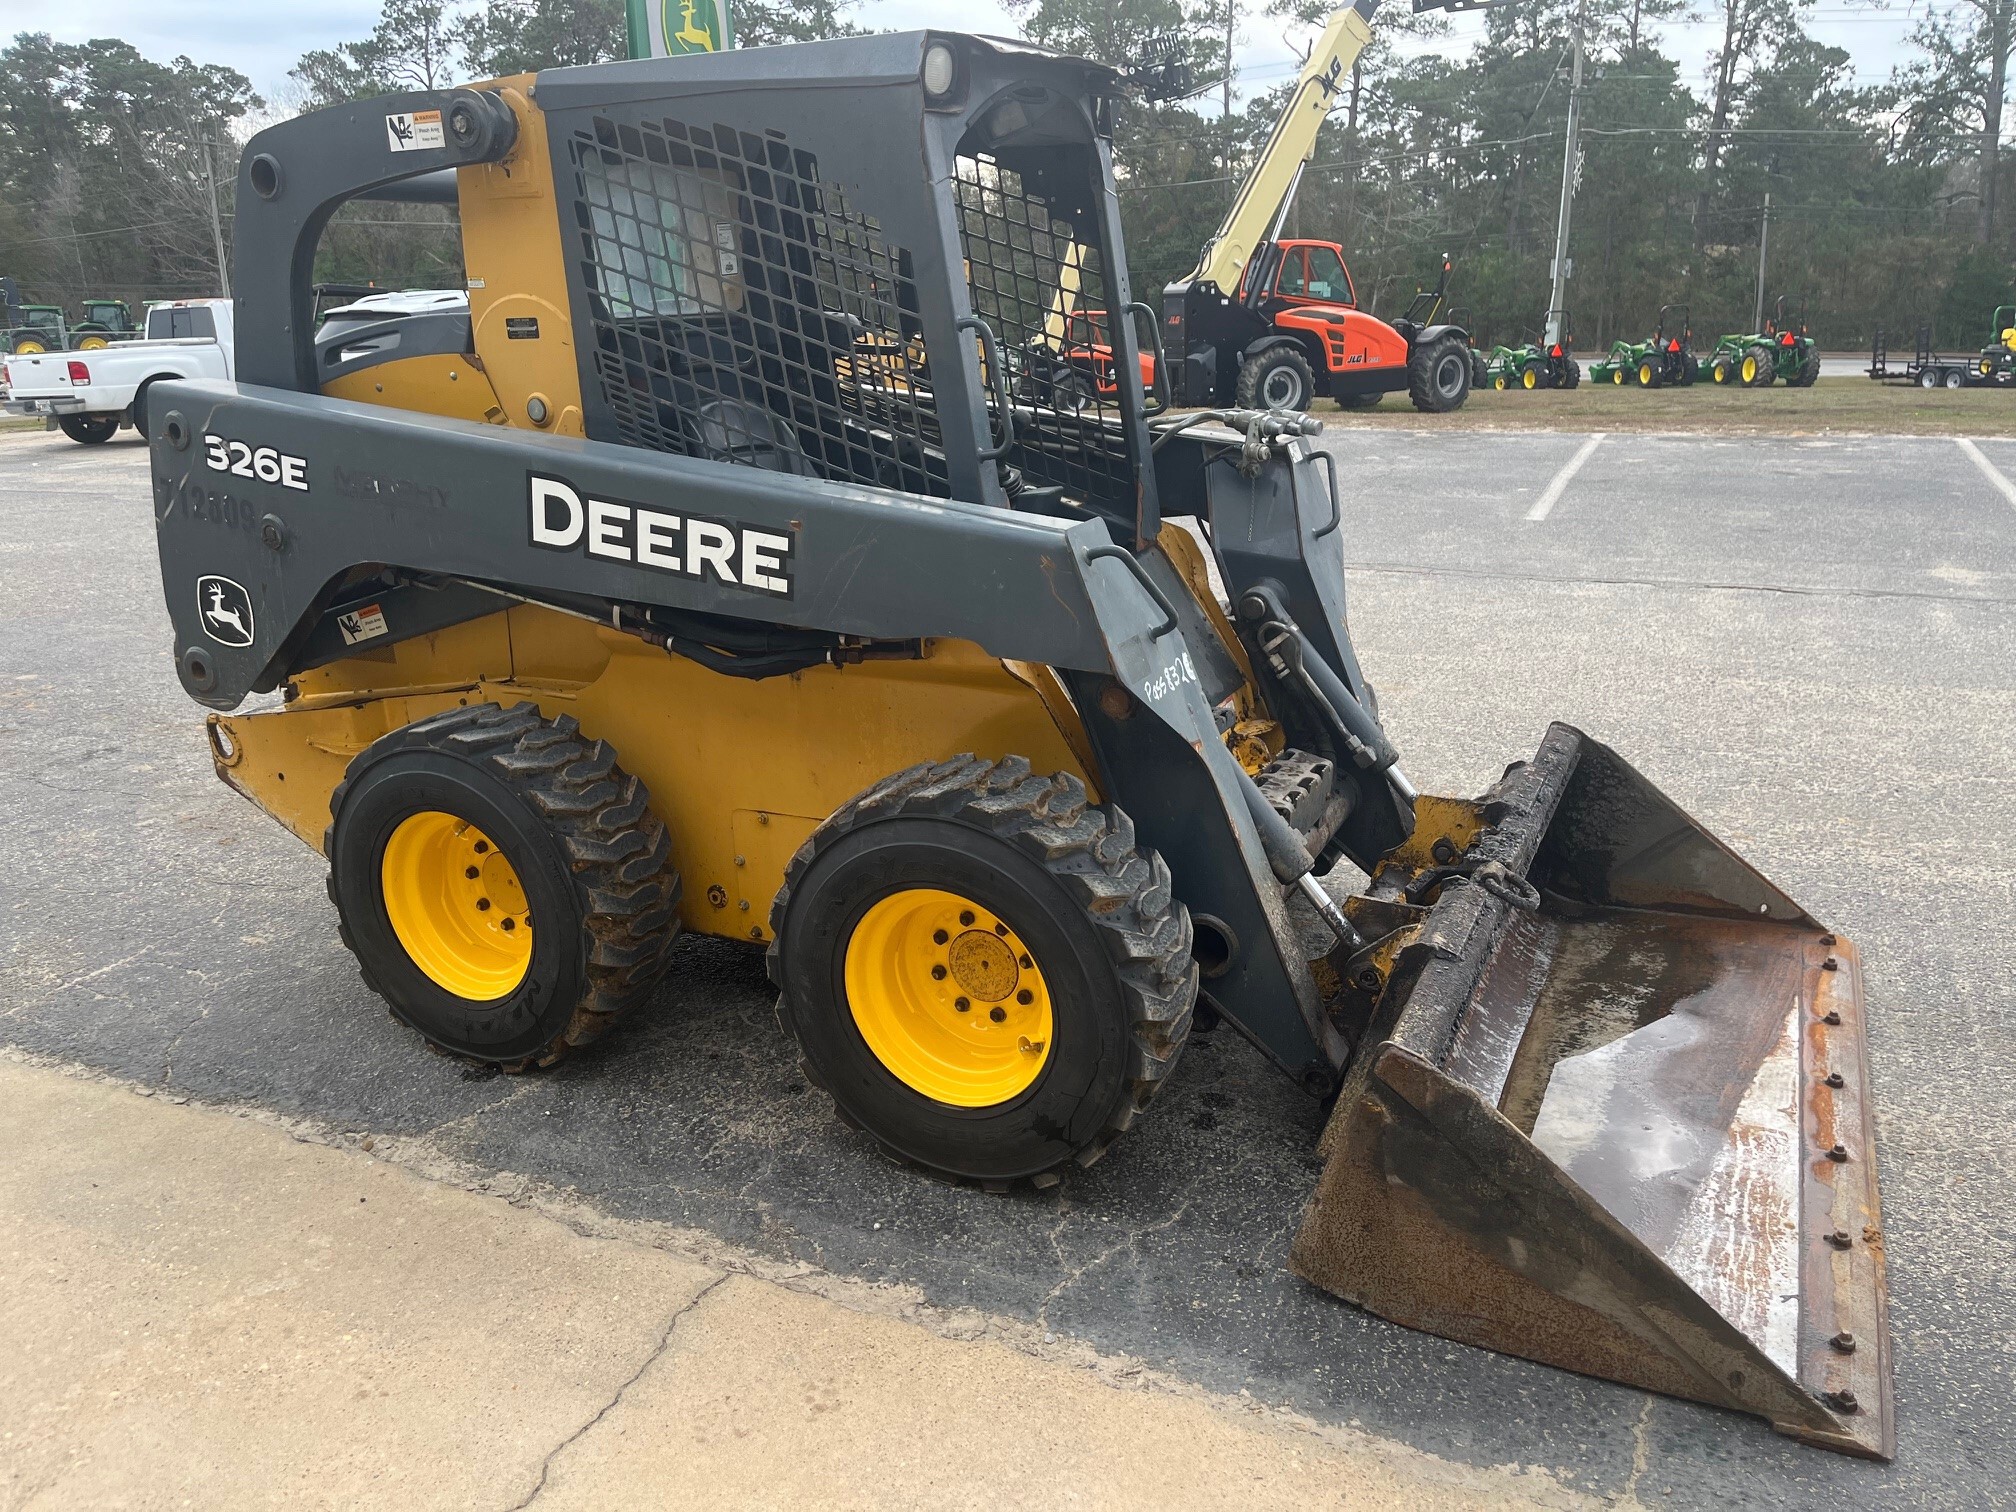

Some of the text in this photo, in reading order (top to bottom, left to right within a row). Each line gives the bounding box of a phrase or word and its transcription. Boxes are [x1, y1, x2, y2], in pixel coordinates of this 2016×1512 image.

[1323, 55, 1342, 100] JLG
[1168, 315, 1181, 325] JLG
[1347, 355, 1363, 364] JLG
[204, 435, 308, 491] 326E
[531, 476, 789, 594] DEERE
